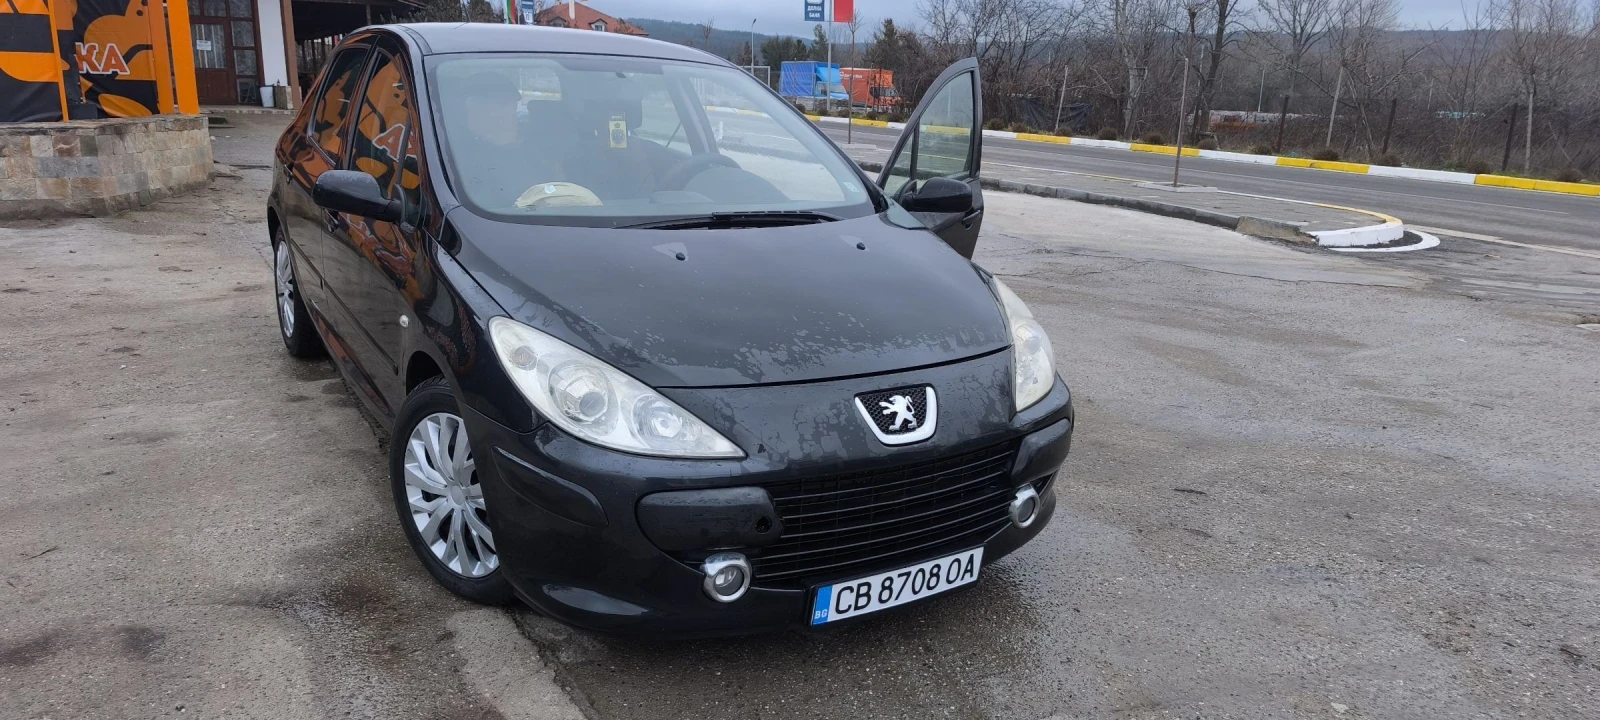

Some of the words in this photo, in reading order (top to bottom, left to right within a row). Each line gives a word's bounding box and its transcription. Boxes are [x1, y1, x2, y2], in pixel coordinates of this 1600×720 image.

[835, 581, 872, 615] CB
[878, 563, 942, 604] 8708
[945, 553, 975, 584] OA
[815, 609, 828, 620] BG
